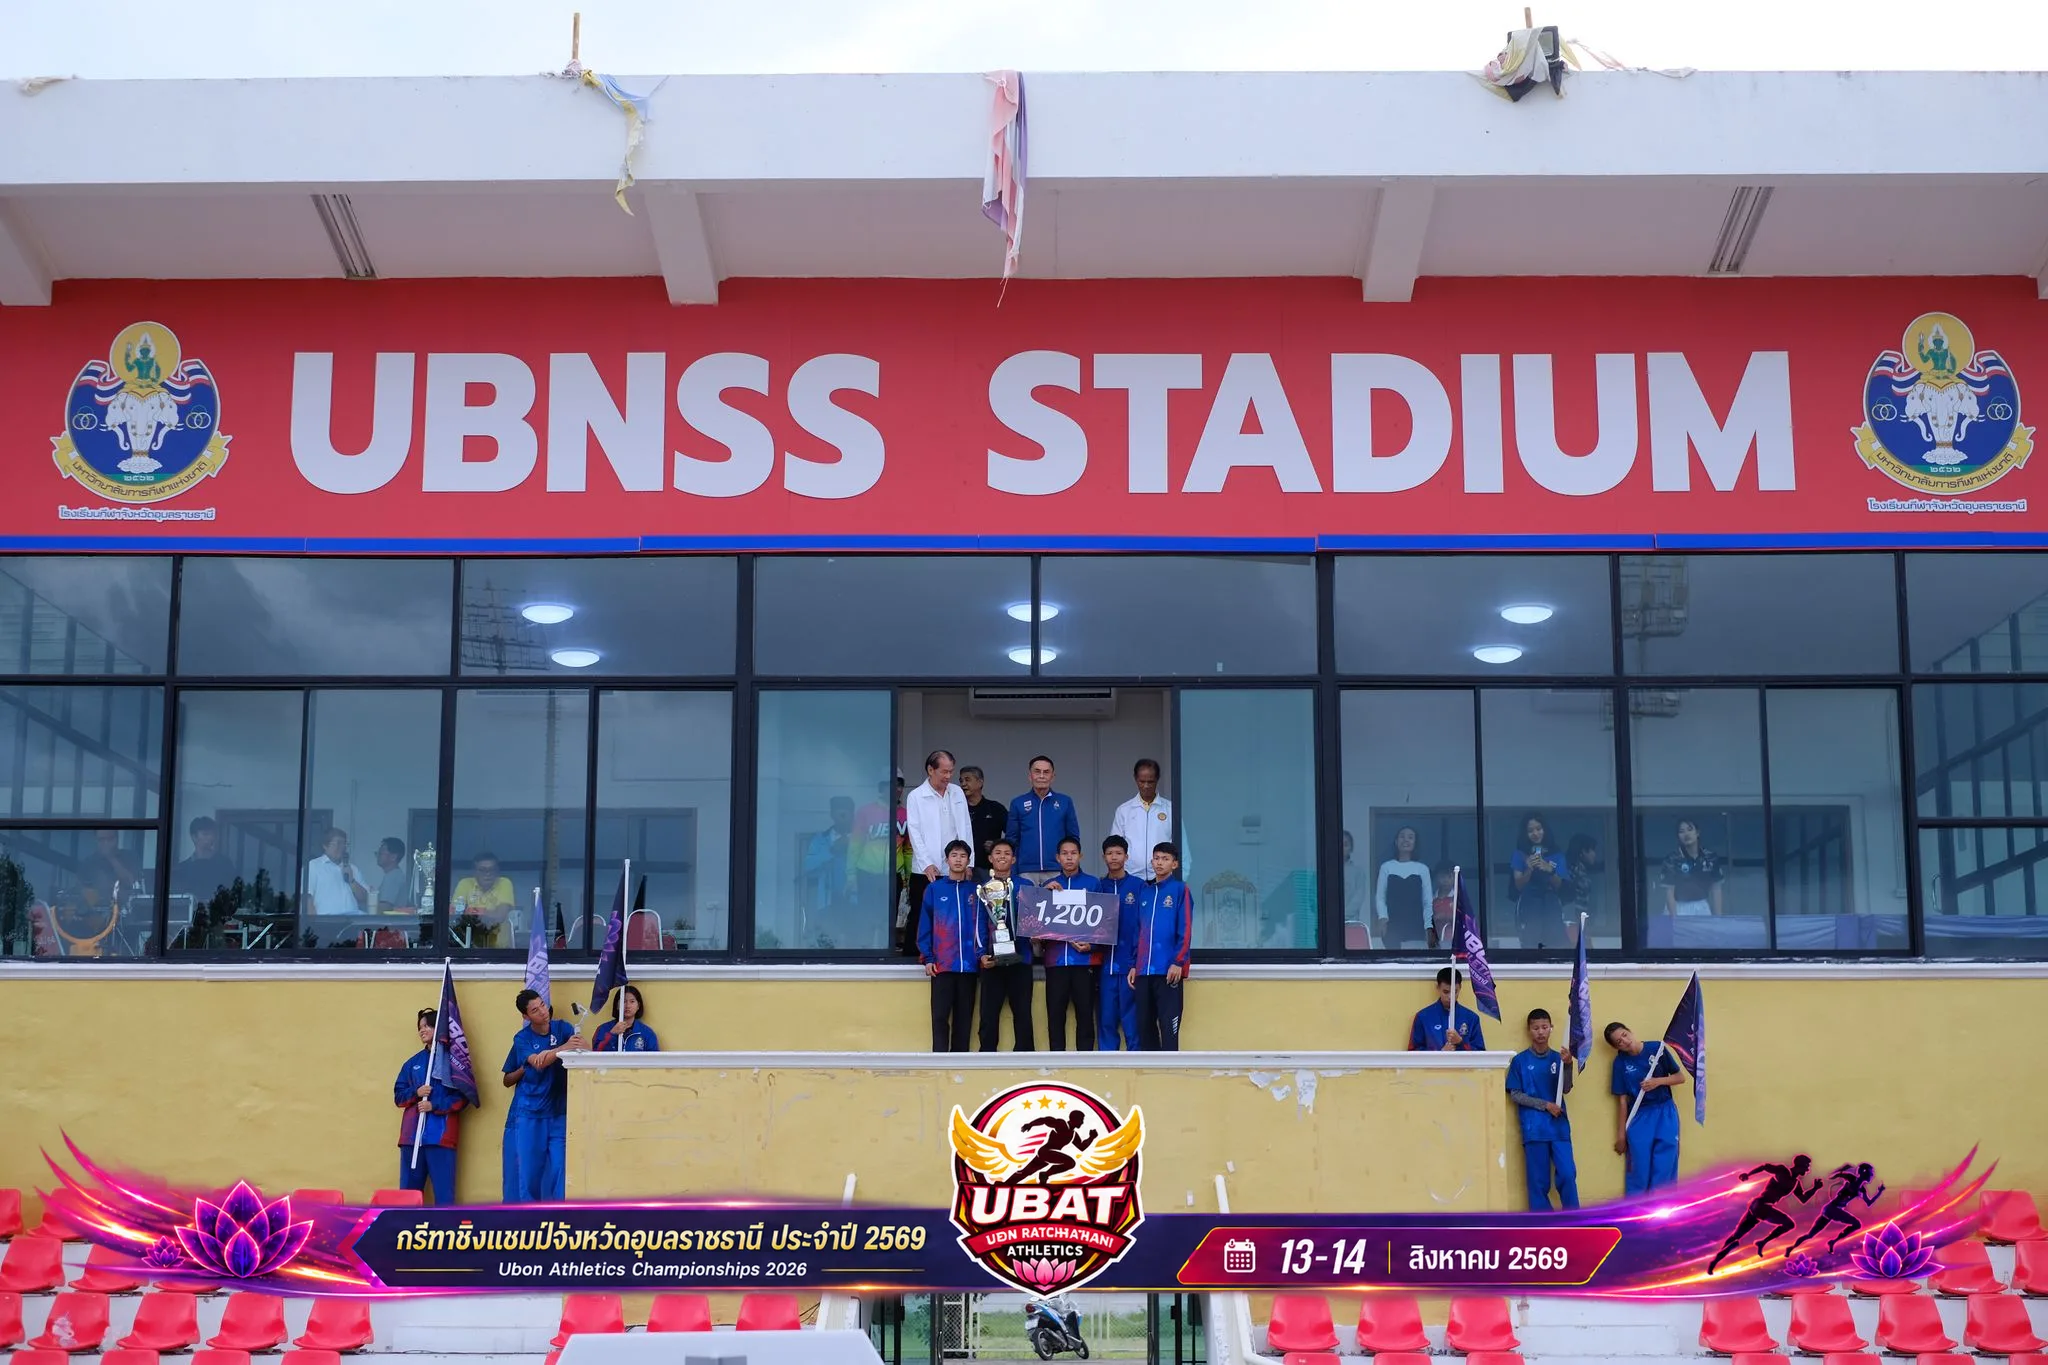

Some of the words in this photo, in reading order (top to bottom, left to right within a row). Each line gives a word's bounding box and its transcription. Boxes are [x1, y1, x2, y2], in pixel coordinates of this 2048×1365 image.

[291, 352, 885, 498] UBNSS
[988, 350, 1796, 495] STADIUM
[1876, 451, 2014, 488] มหาวิทยาลัยการกีฬาแห่งชาติ
[59, 506, 215, 521] โรงเรียนกีฬาจังหวัดอุบลราชธานี
[1868, 499, 2026, 514] โรงเรียนกีฬาจังหวัดอุบลราชธานี
[1036, 900, 1103, 927] 1,200
